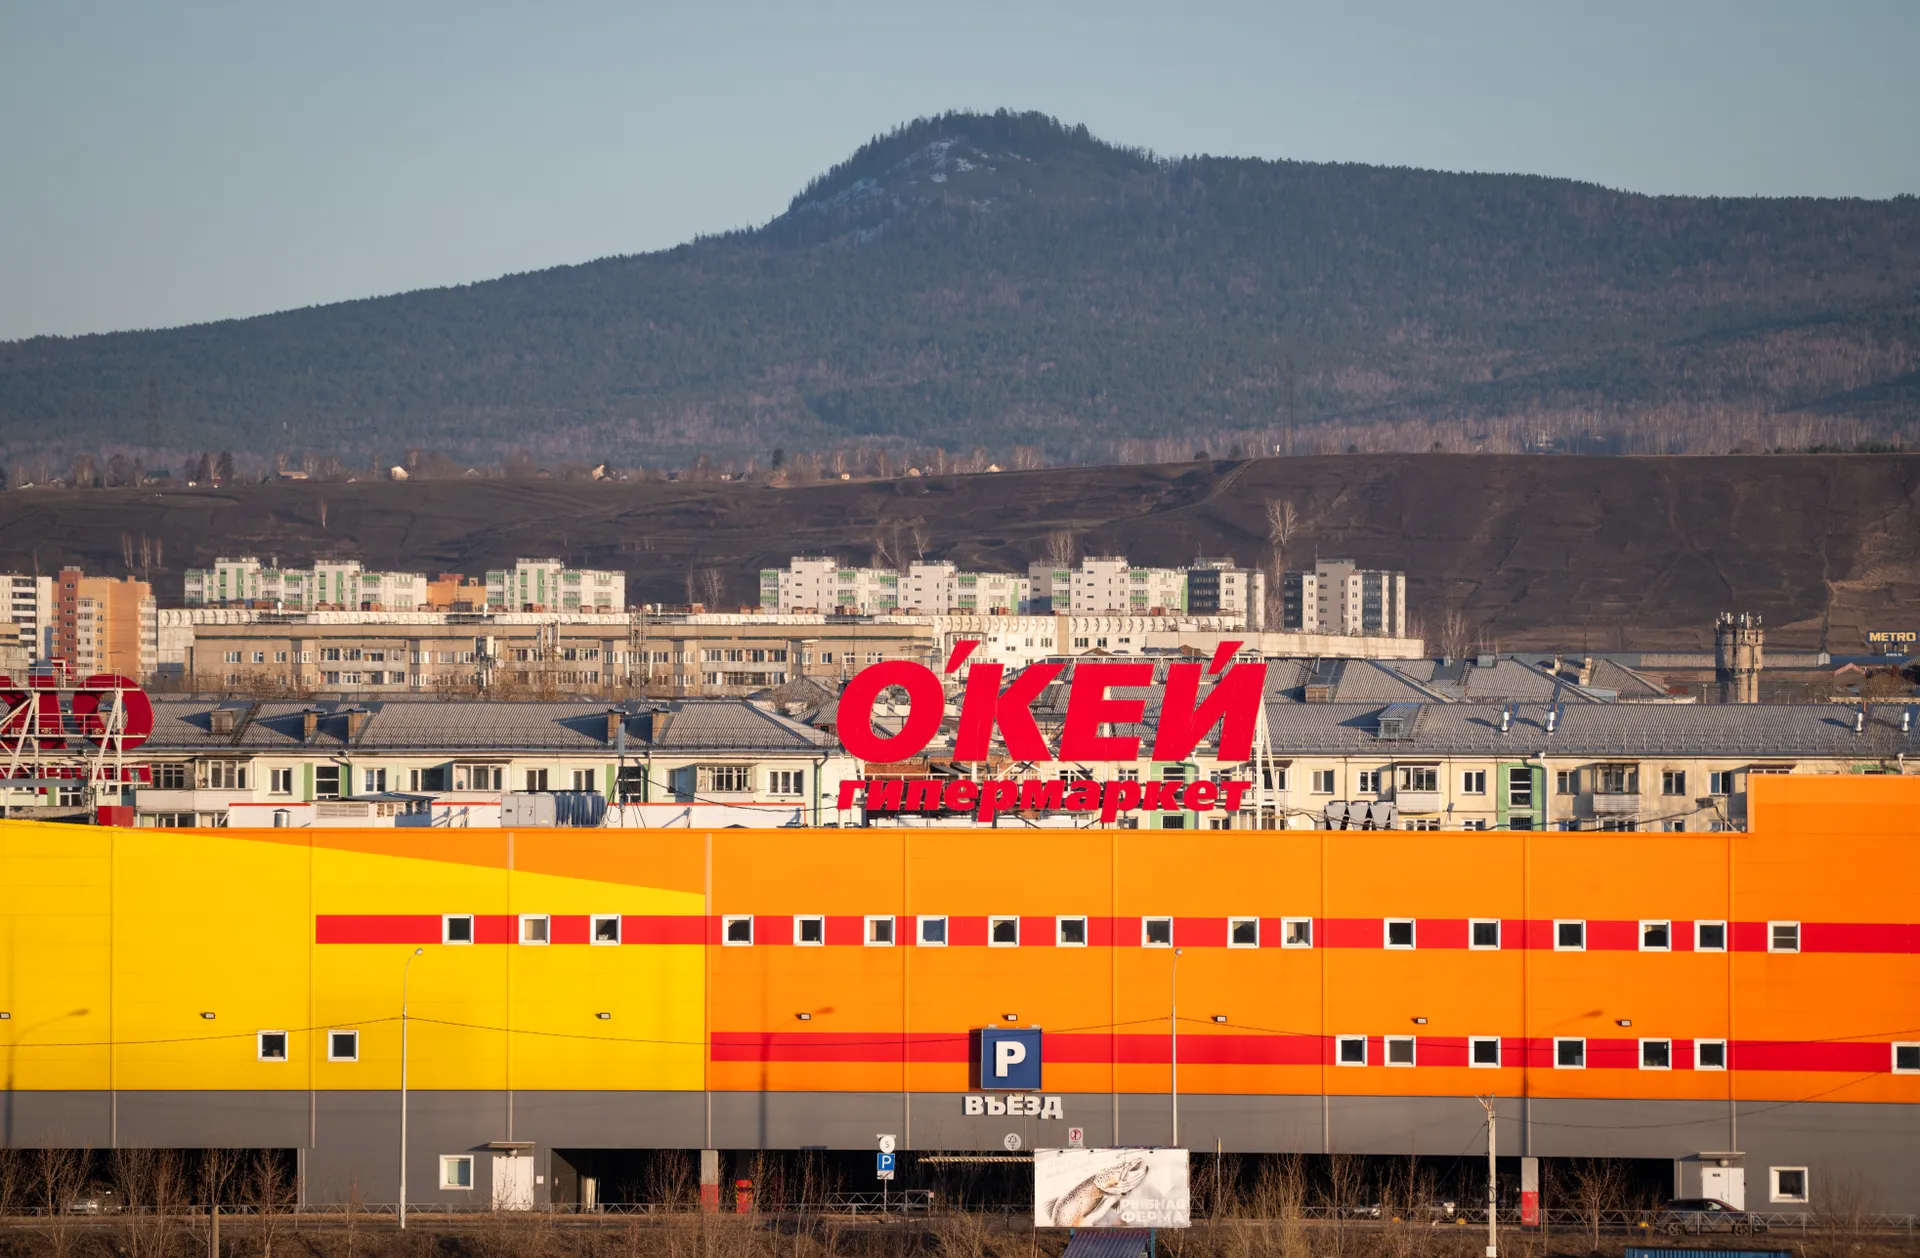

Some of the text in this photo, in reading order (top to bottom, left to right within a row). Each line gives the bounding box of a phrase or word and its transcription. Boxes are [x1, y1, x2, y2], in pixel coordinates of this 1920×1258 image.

[1869, 631, 1917, 642] METRO
[836, 639, 1268, 764] О'КЕЙ
[836, 779, 1252, 823] гипермаркет
[995, 1040, 1027, 1077] P
[964, 1095, 1064, 1120] ВЪЕЗД
[881, 1155, 892, 1169] P
[1120, 1210, 1186, 1224] ФЕРМА
